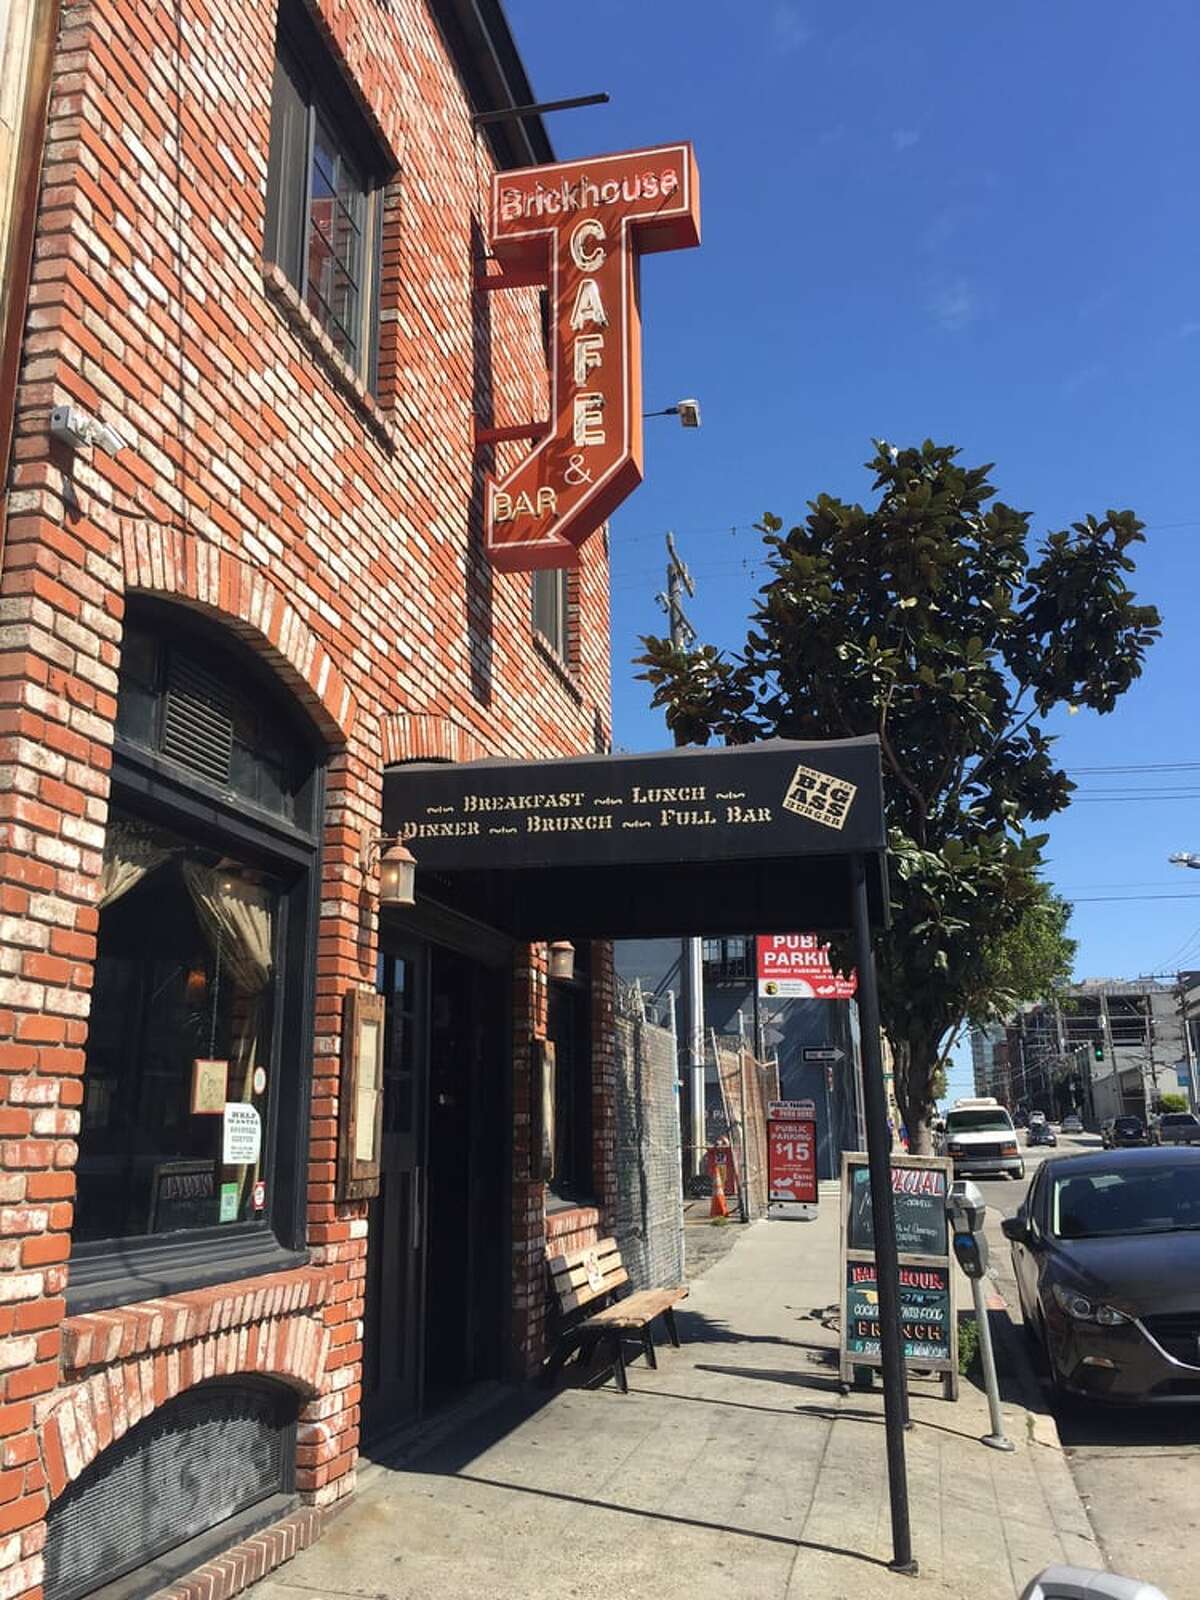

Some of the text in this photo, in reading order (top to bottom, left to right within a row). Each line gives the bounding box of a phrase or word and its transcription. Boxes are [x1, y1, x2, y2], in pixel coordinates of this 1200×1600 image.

[500, 169, 679, 221] Brickhouse
[570, 218, 609, 447] CAFE
[564, 454, 594, 485] &
[492, 486, 558, 522] BAR
[463, 787, 706, 813] BREAKFAST LUNCH
[789, 788, 845, 817] ASS
[796, 773, 850, 804] BIG
[403, 806, 772, 839] DINNER BRUNCH FULL BAR
[773, 935, 821, 949] PUB
[764, 951, 830, 966] PARKI
[775, 1141, 810, 1162] $15
